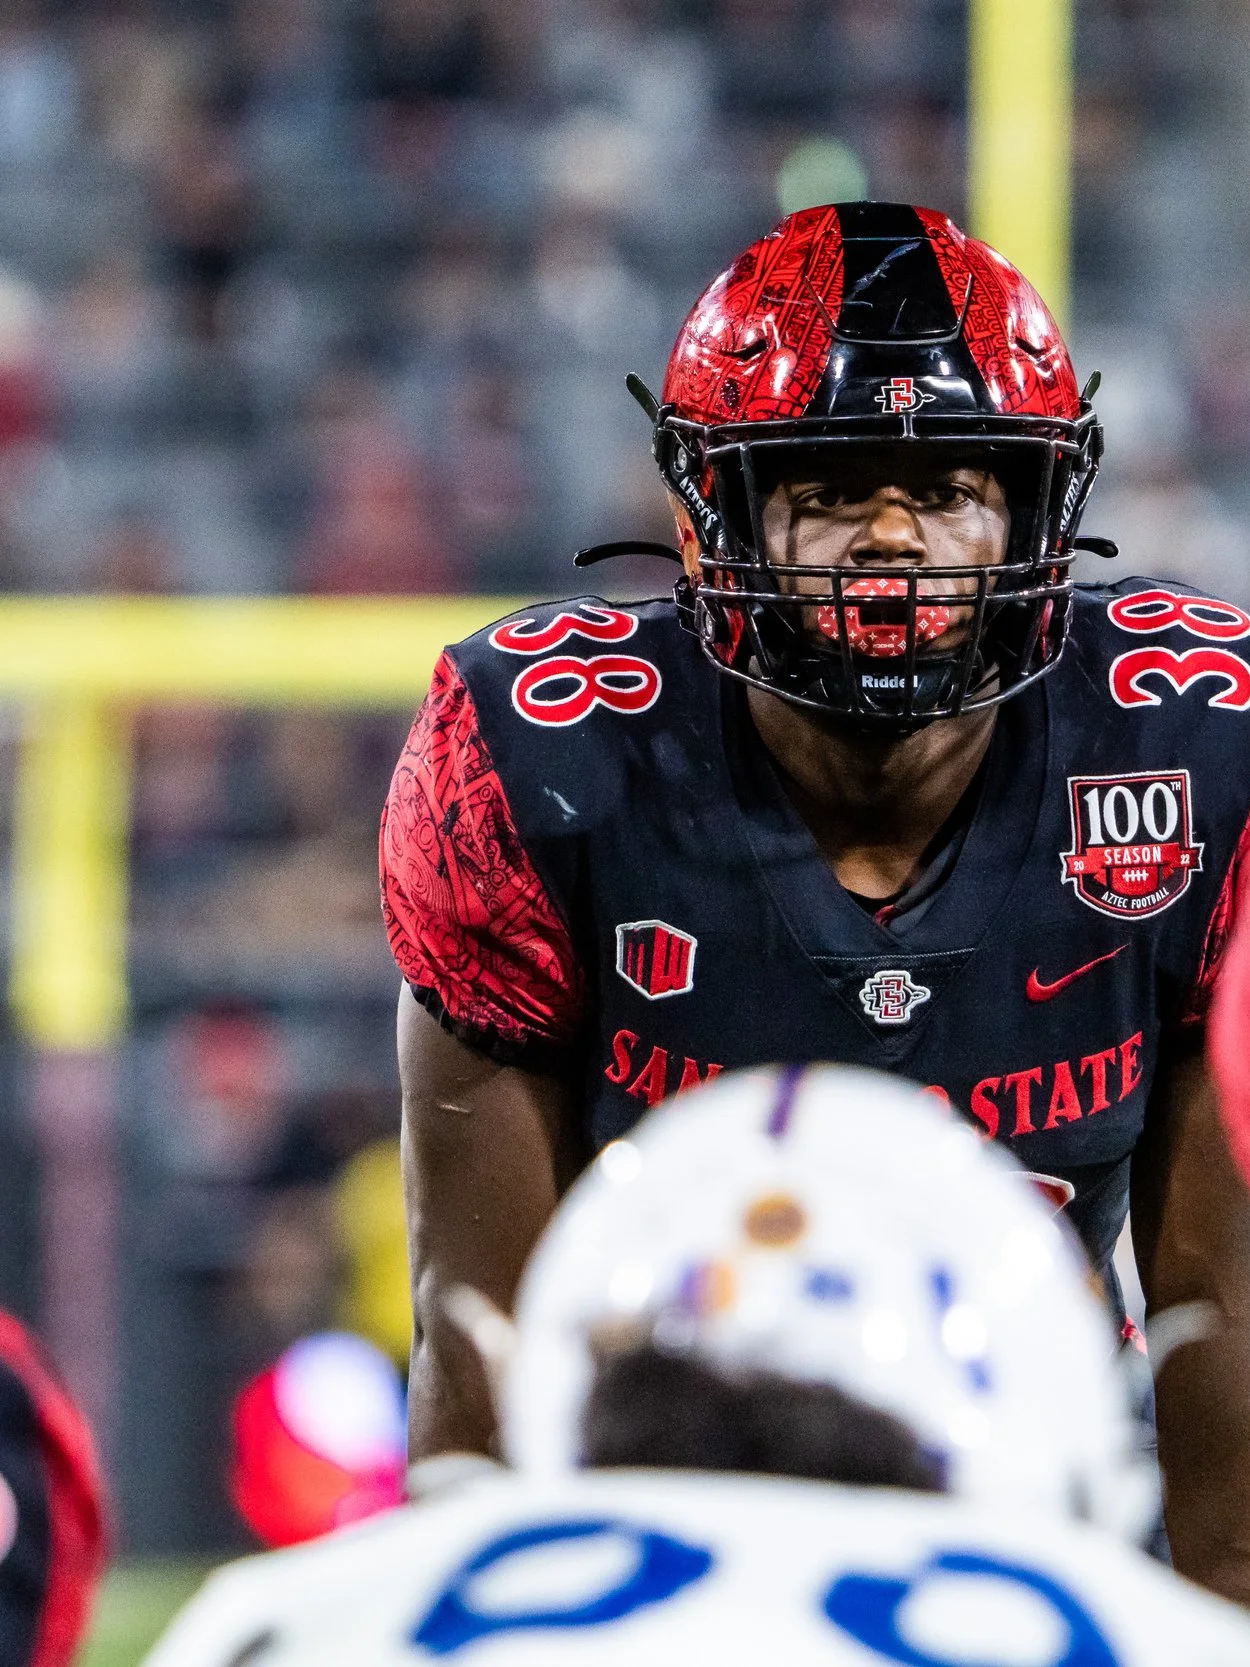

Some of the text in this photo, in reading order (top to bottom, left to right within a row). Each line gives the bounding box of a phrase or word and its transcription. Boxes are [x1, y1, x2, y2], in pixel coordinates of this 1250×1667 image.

[679, 475, 719, 530] AZTECS
[487, 603, 663, 728] 38
[861, 674, 919, 689] Riddel
[1073, 860, 1085, 872] 20
[1104, 845, 1162, 865] SEASON
[1180, 853, 1190, 865] 22
[1101, 886, 1170, 910] AZTEC FOOTBALL
[970, 1030, 1143, 1138] STATE
